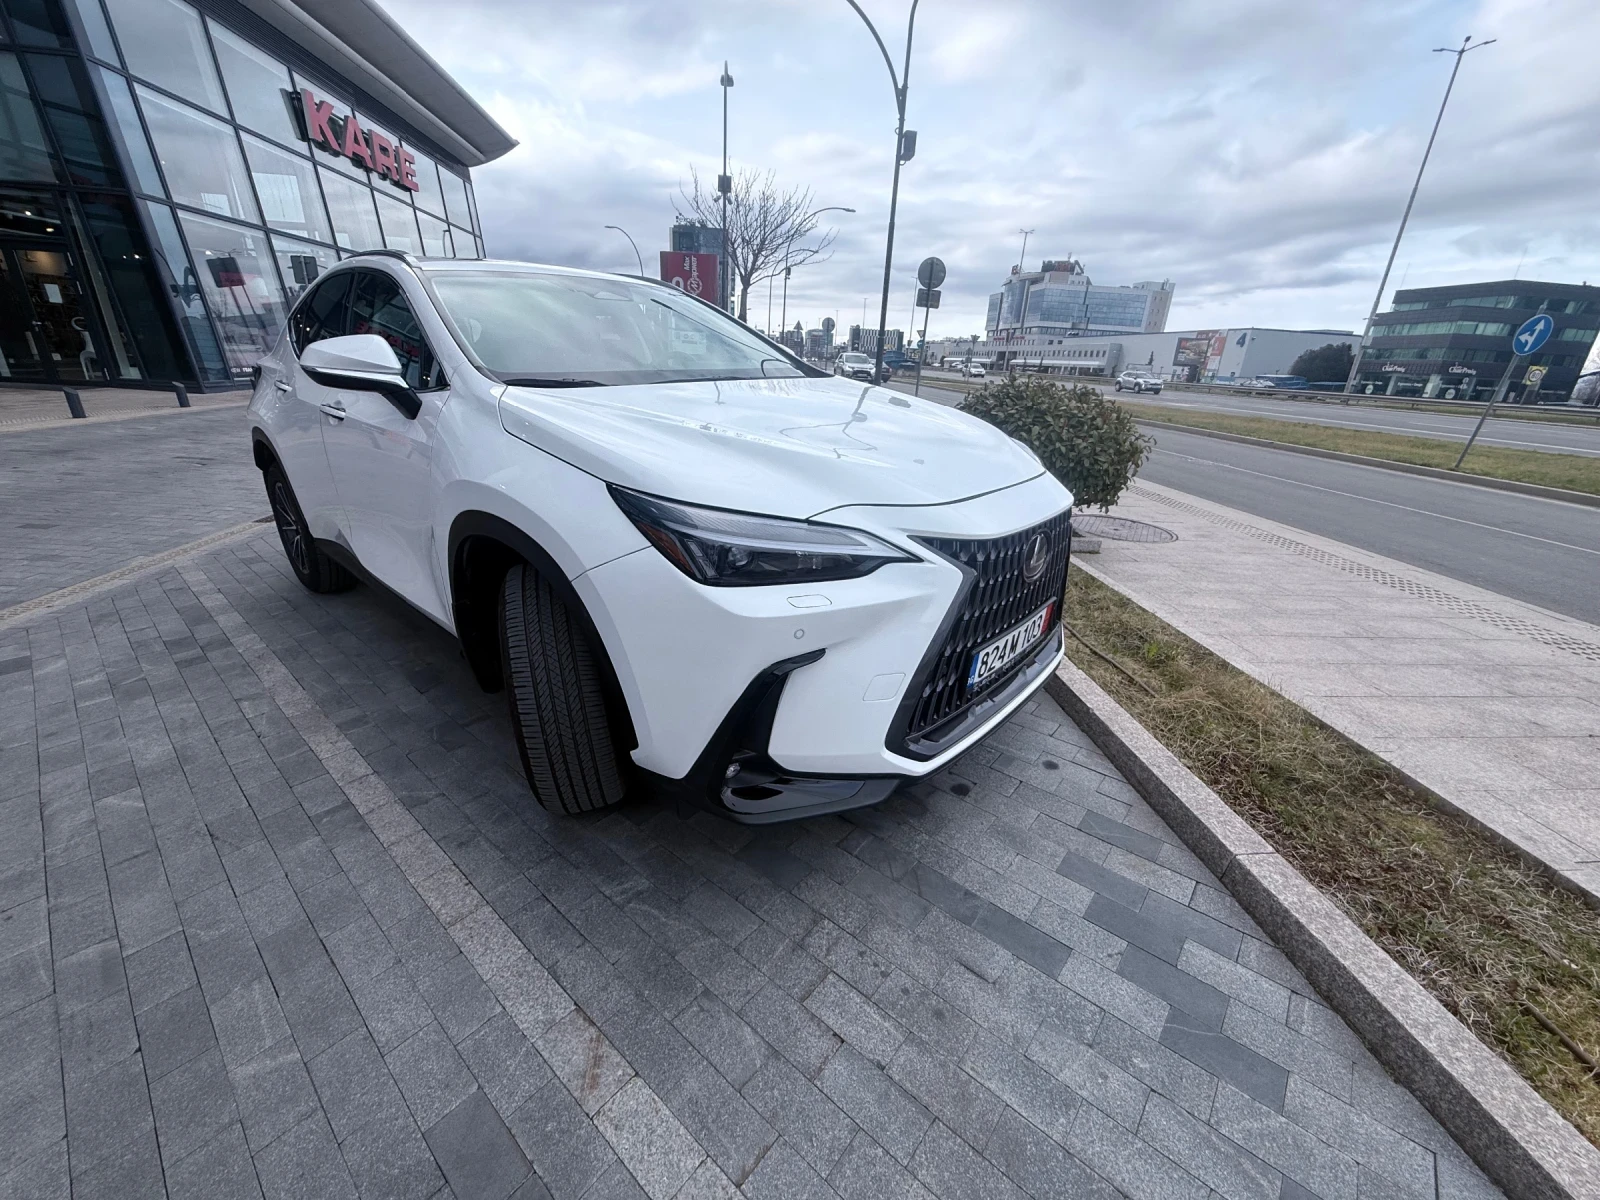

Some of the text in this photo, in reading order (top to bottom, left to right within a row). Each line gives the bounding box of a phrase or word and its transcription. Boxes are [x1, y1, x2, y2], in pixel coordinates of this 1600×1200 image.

[300, 88, 420, 192] KARE
[978, 638, 1009, 679] 824
[1007, 630, 1021, 659] M
